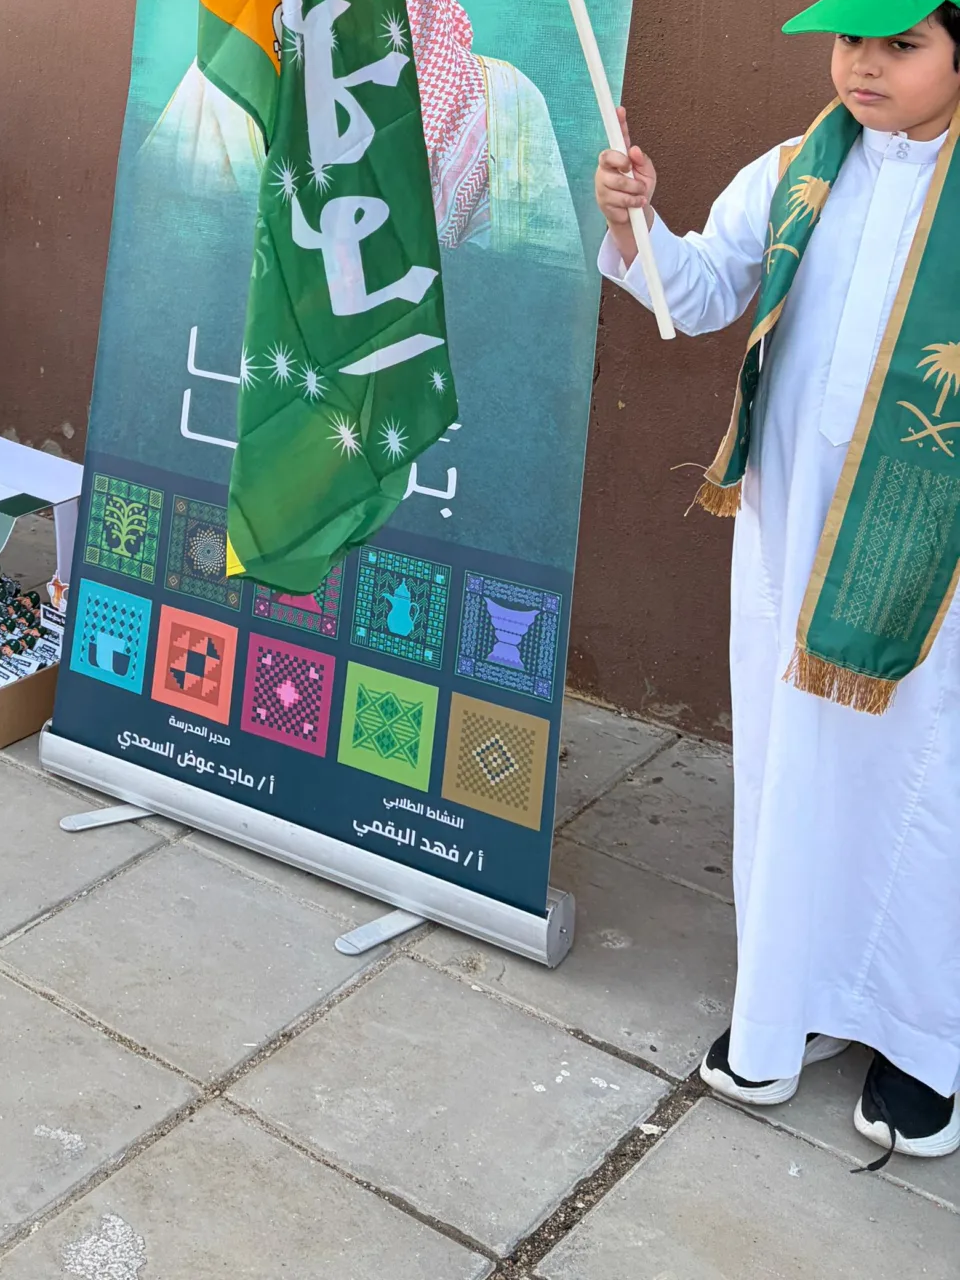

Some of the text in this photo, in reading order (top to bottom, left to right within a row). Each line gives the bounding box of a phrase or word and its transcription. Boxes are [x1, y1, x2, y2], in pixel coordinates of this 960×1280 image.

[168, 715, 231, 746] مدير المدرسة
[117, 730, 175, 759] السعدي
[177, 750, 215, 774] عوض
[218, 764, 254, 788] ماجد
[269, 775, 275, 795] أ
[383, 797, 464, 829] النشاط الطلابي
[353, 819, 416, 846] البقمي
[420, 837, 460, 863] فهد
[477, 850, 484, 871] أ
